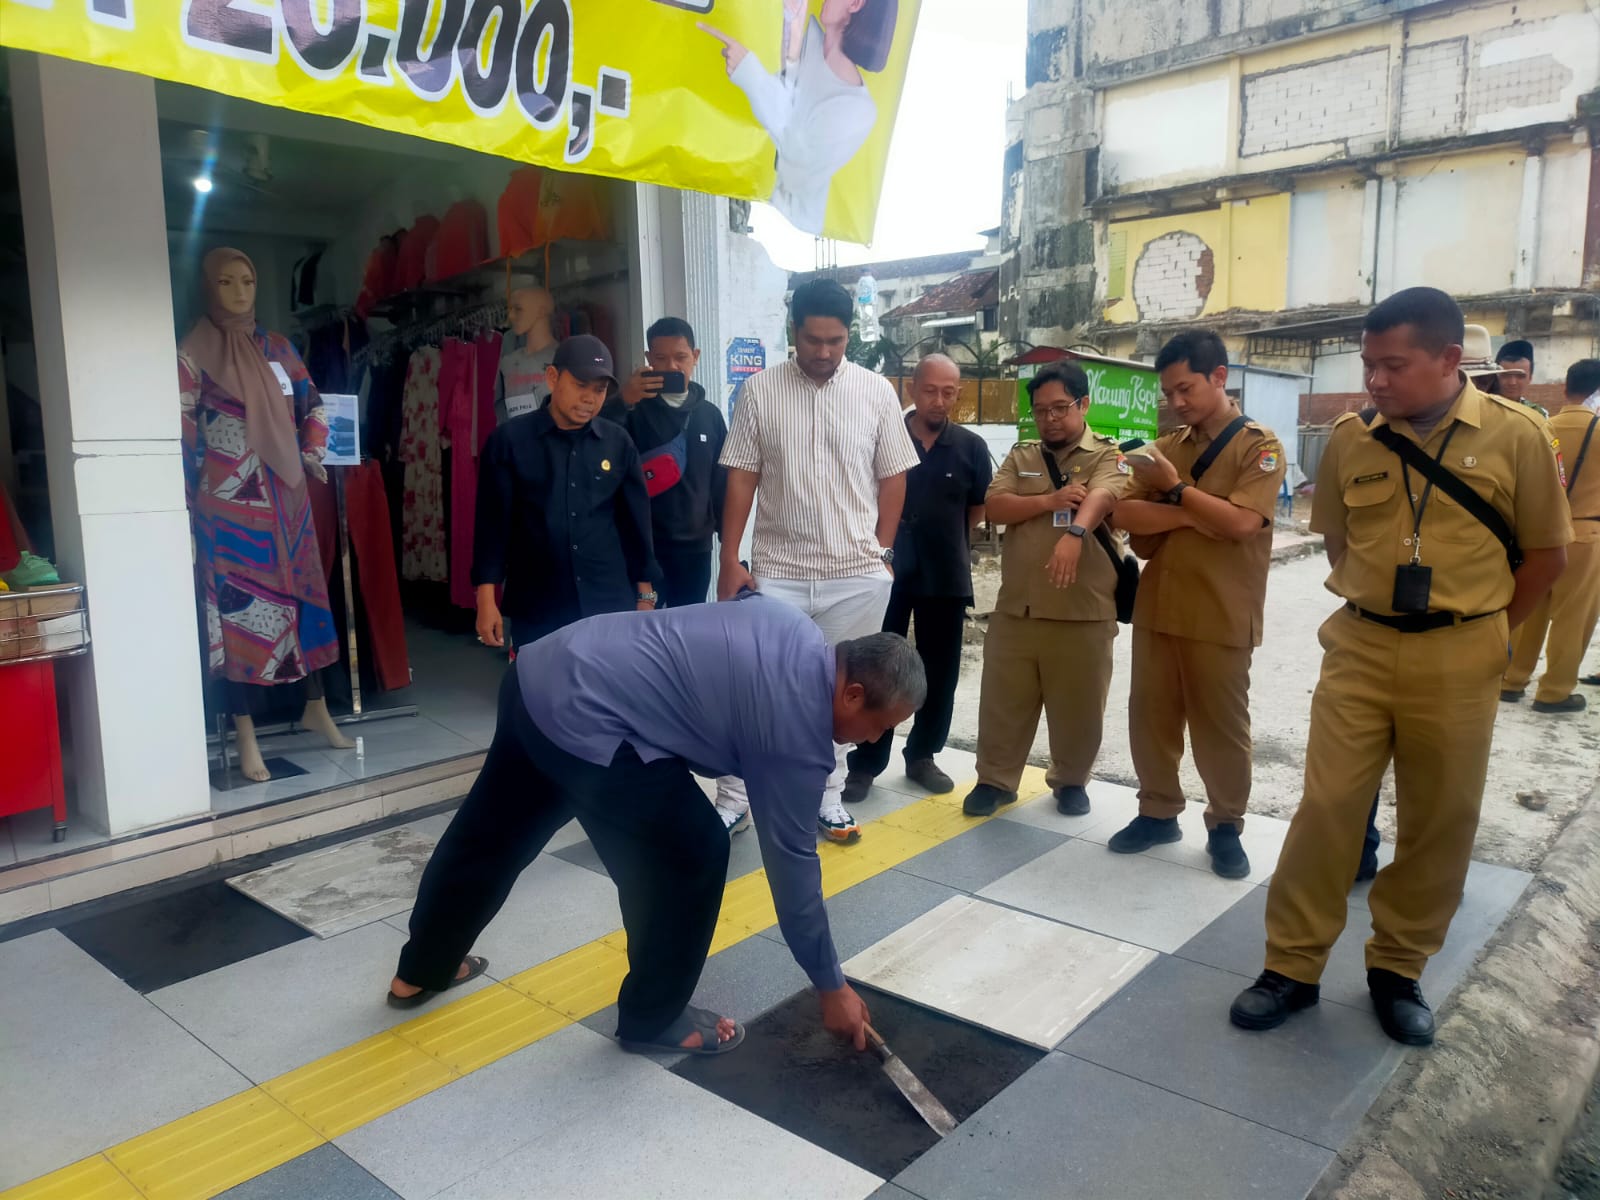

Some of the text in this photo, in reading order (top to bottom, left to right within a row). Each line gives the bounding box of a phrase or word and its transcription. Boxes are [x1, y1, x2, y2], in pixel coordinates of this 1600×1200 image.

[730, 354, 762, 366] KING
[1086, 368, 1157, 419] Warung Kopi
